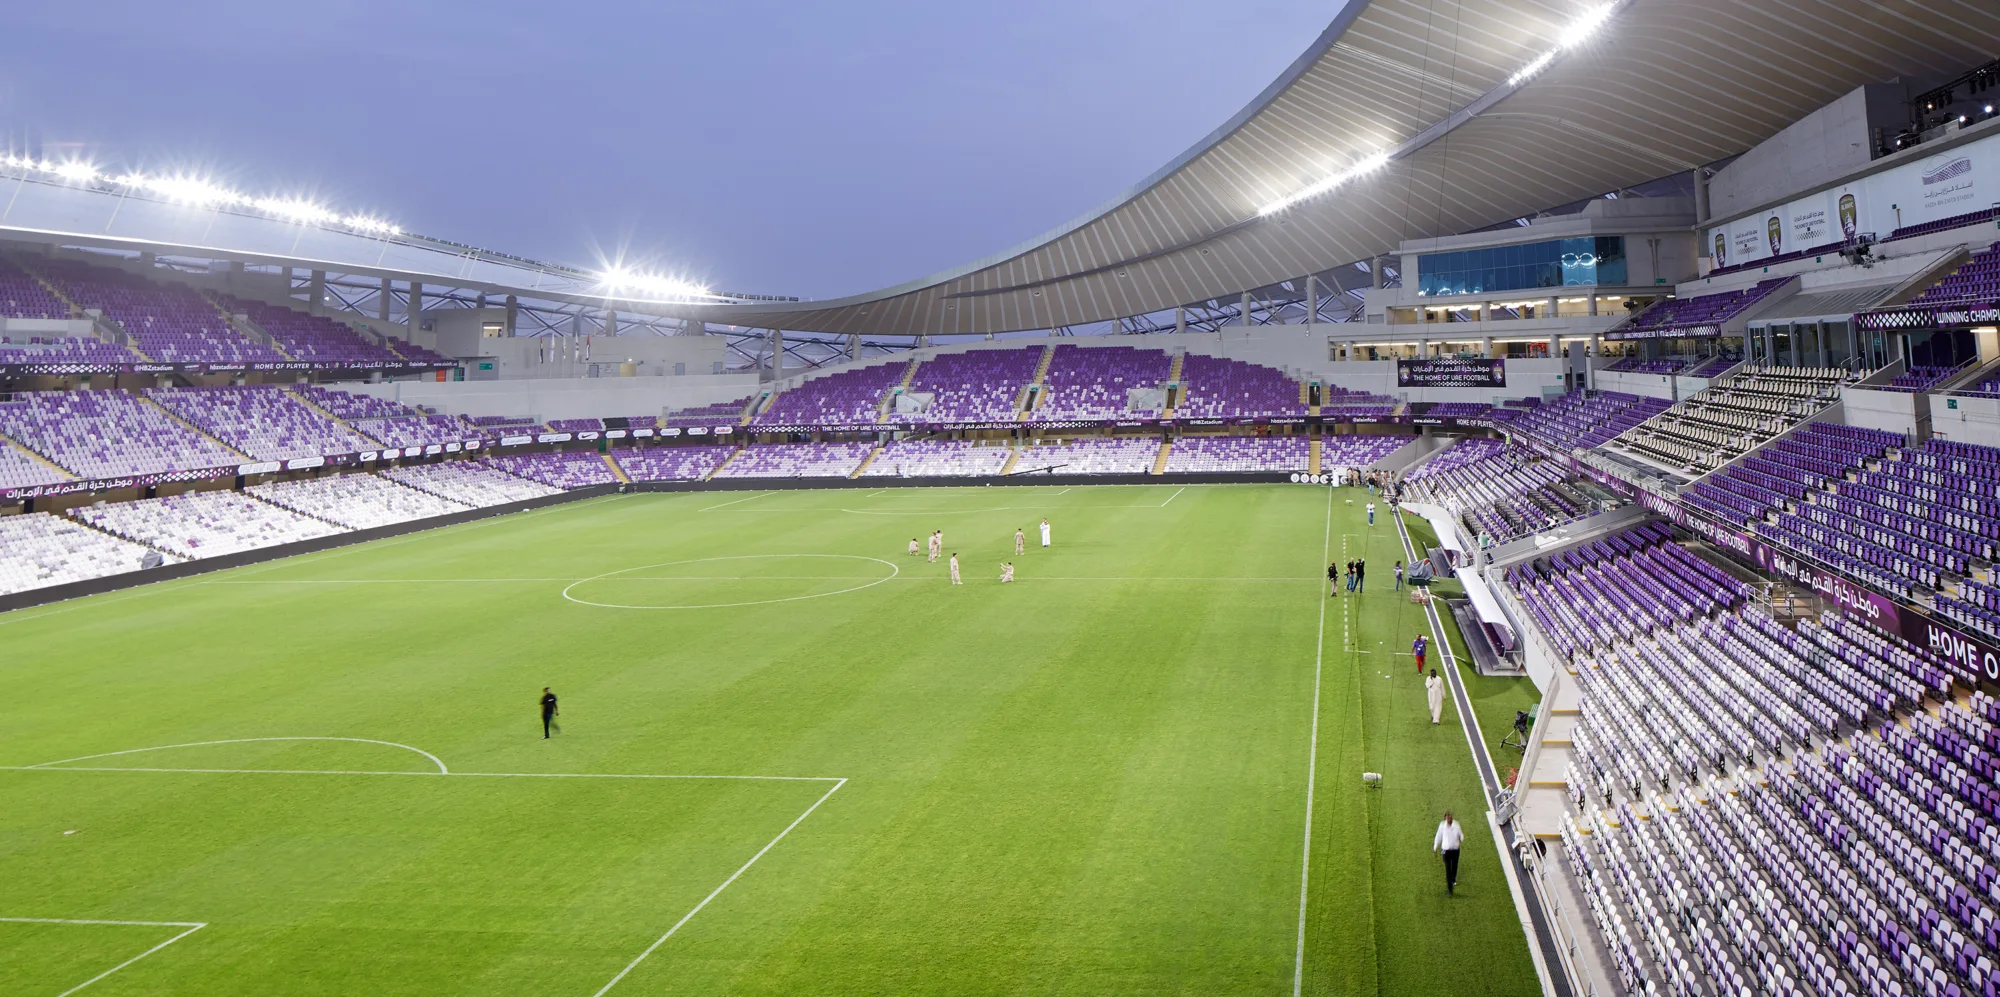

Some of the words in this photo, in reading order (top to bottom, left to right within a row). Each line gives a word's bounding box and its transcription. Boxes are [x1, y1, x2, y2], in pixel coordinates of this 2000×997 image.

[1937, 311, 1969, 323] WINNING
[134, 364, 173, 372] @HBZstadium
[975, 422, 992, 430] القدم
[992, 422, 1003, 430] كرة
[1457, 418, 1470, 426] HOME
[1470, 419, 1477, 427] OF
[61, 482, 88, 494] القدم
[89, 480, 105, 491] كرة
[107, 479, 133, 488] موطن
[6, 486, 43, 499] الإمارات
[1685, 513, 1695, 528] THE
[1695, 518, 1708, 534] HOME
[1708, 524, 1714, 537] OF
[1714, 527, 1725, 543] UAE
[1725, 531, 1750, 555] FOOTBALL
[1774, 554, 1798, 580] الإم
[1812, 576, 1834, 595] القدم
[1835, 580, 1850, 603] كرة
[1850, 590, 1880, 618] موطن
[1928, 625, 1979, 671] HOME
[1984, 652, 2000, 679] O
